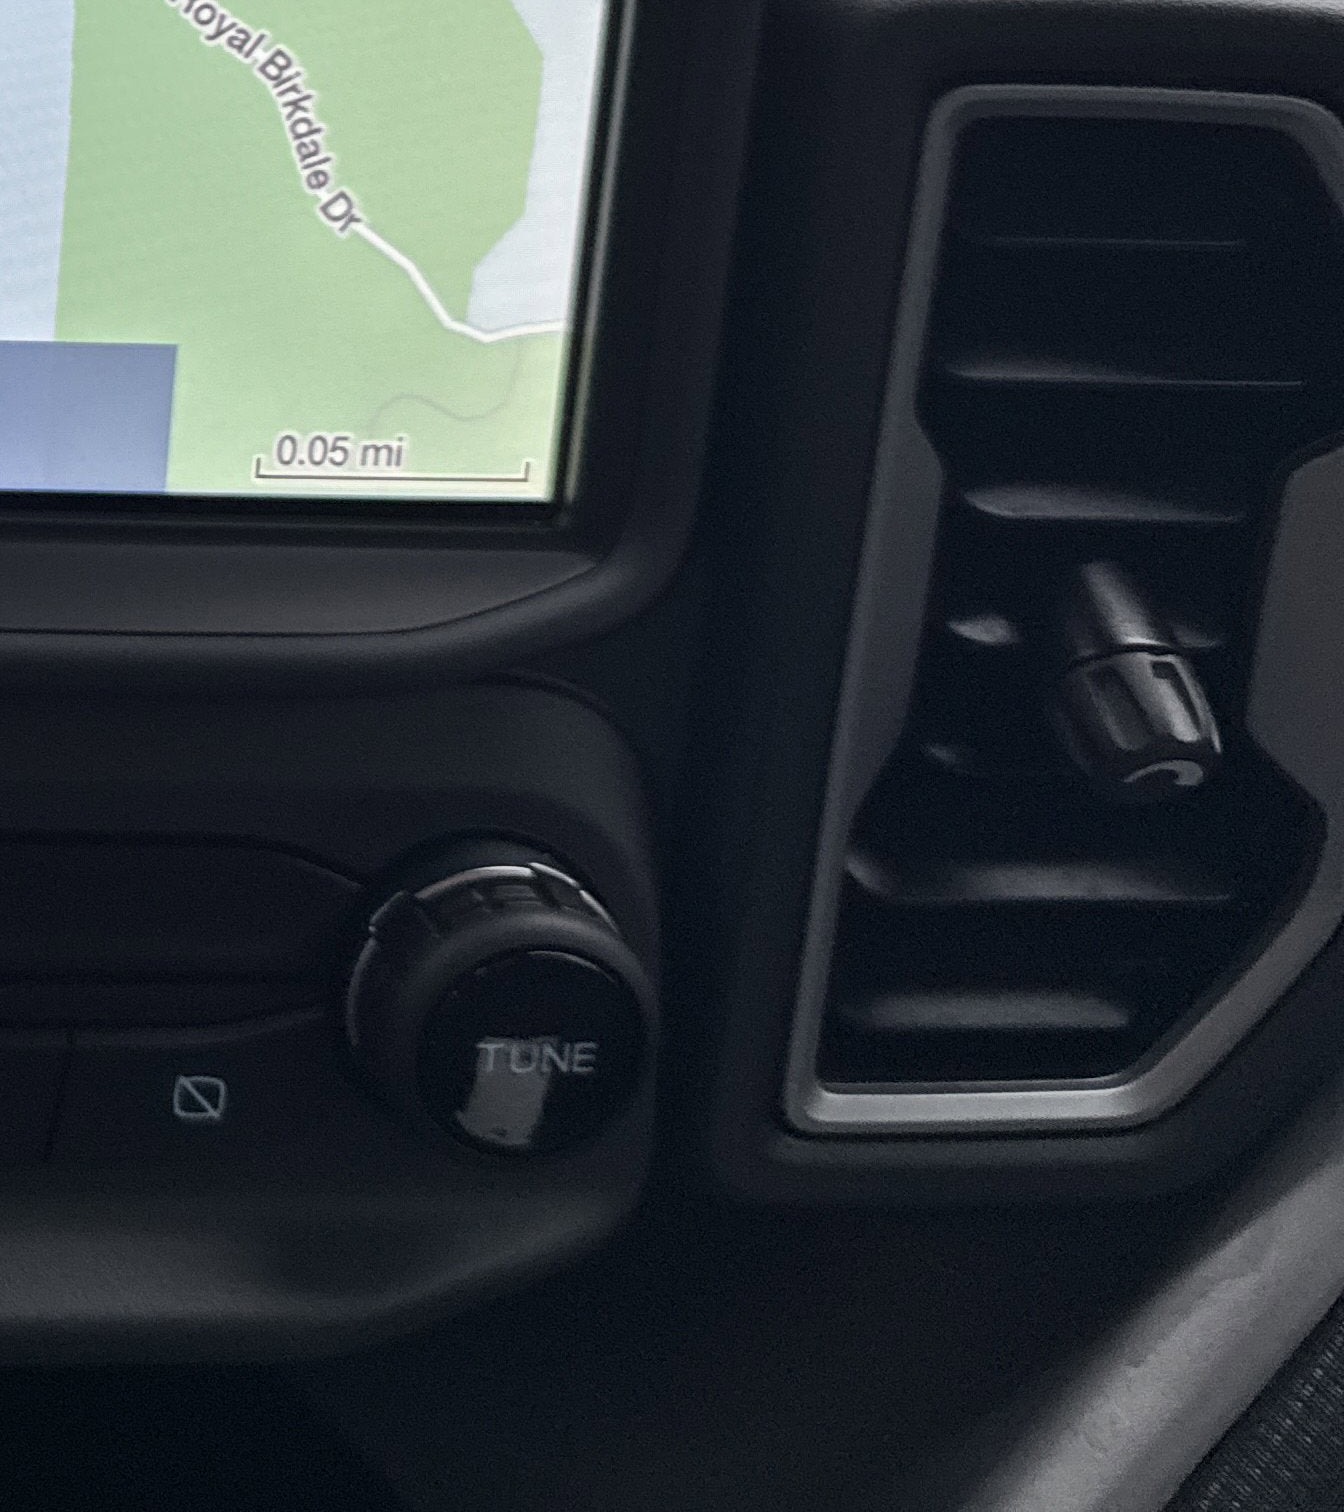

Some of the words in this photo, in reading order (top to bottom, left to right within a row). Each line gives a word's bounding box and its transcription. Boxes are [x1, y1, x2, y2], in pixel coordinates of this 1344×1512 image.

[258, 48, 332, 190] Birkdale
[320, 191, 363, 232] Dr
[276, 434, 350, 467] 0.05
[359, 435, 404, 467] mi
[475, 1040, 600, 1074] TUNE
